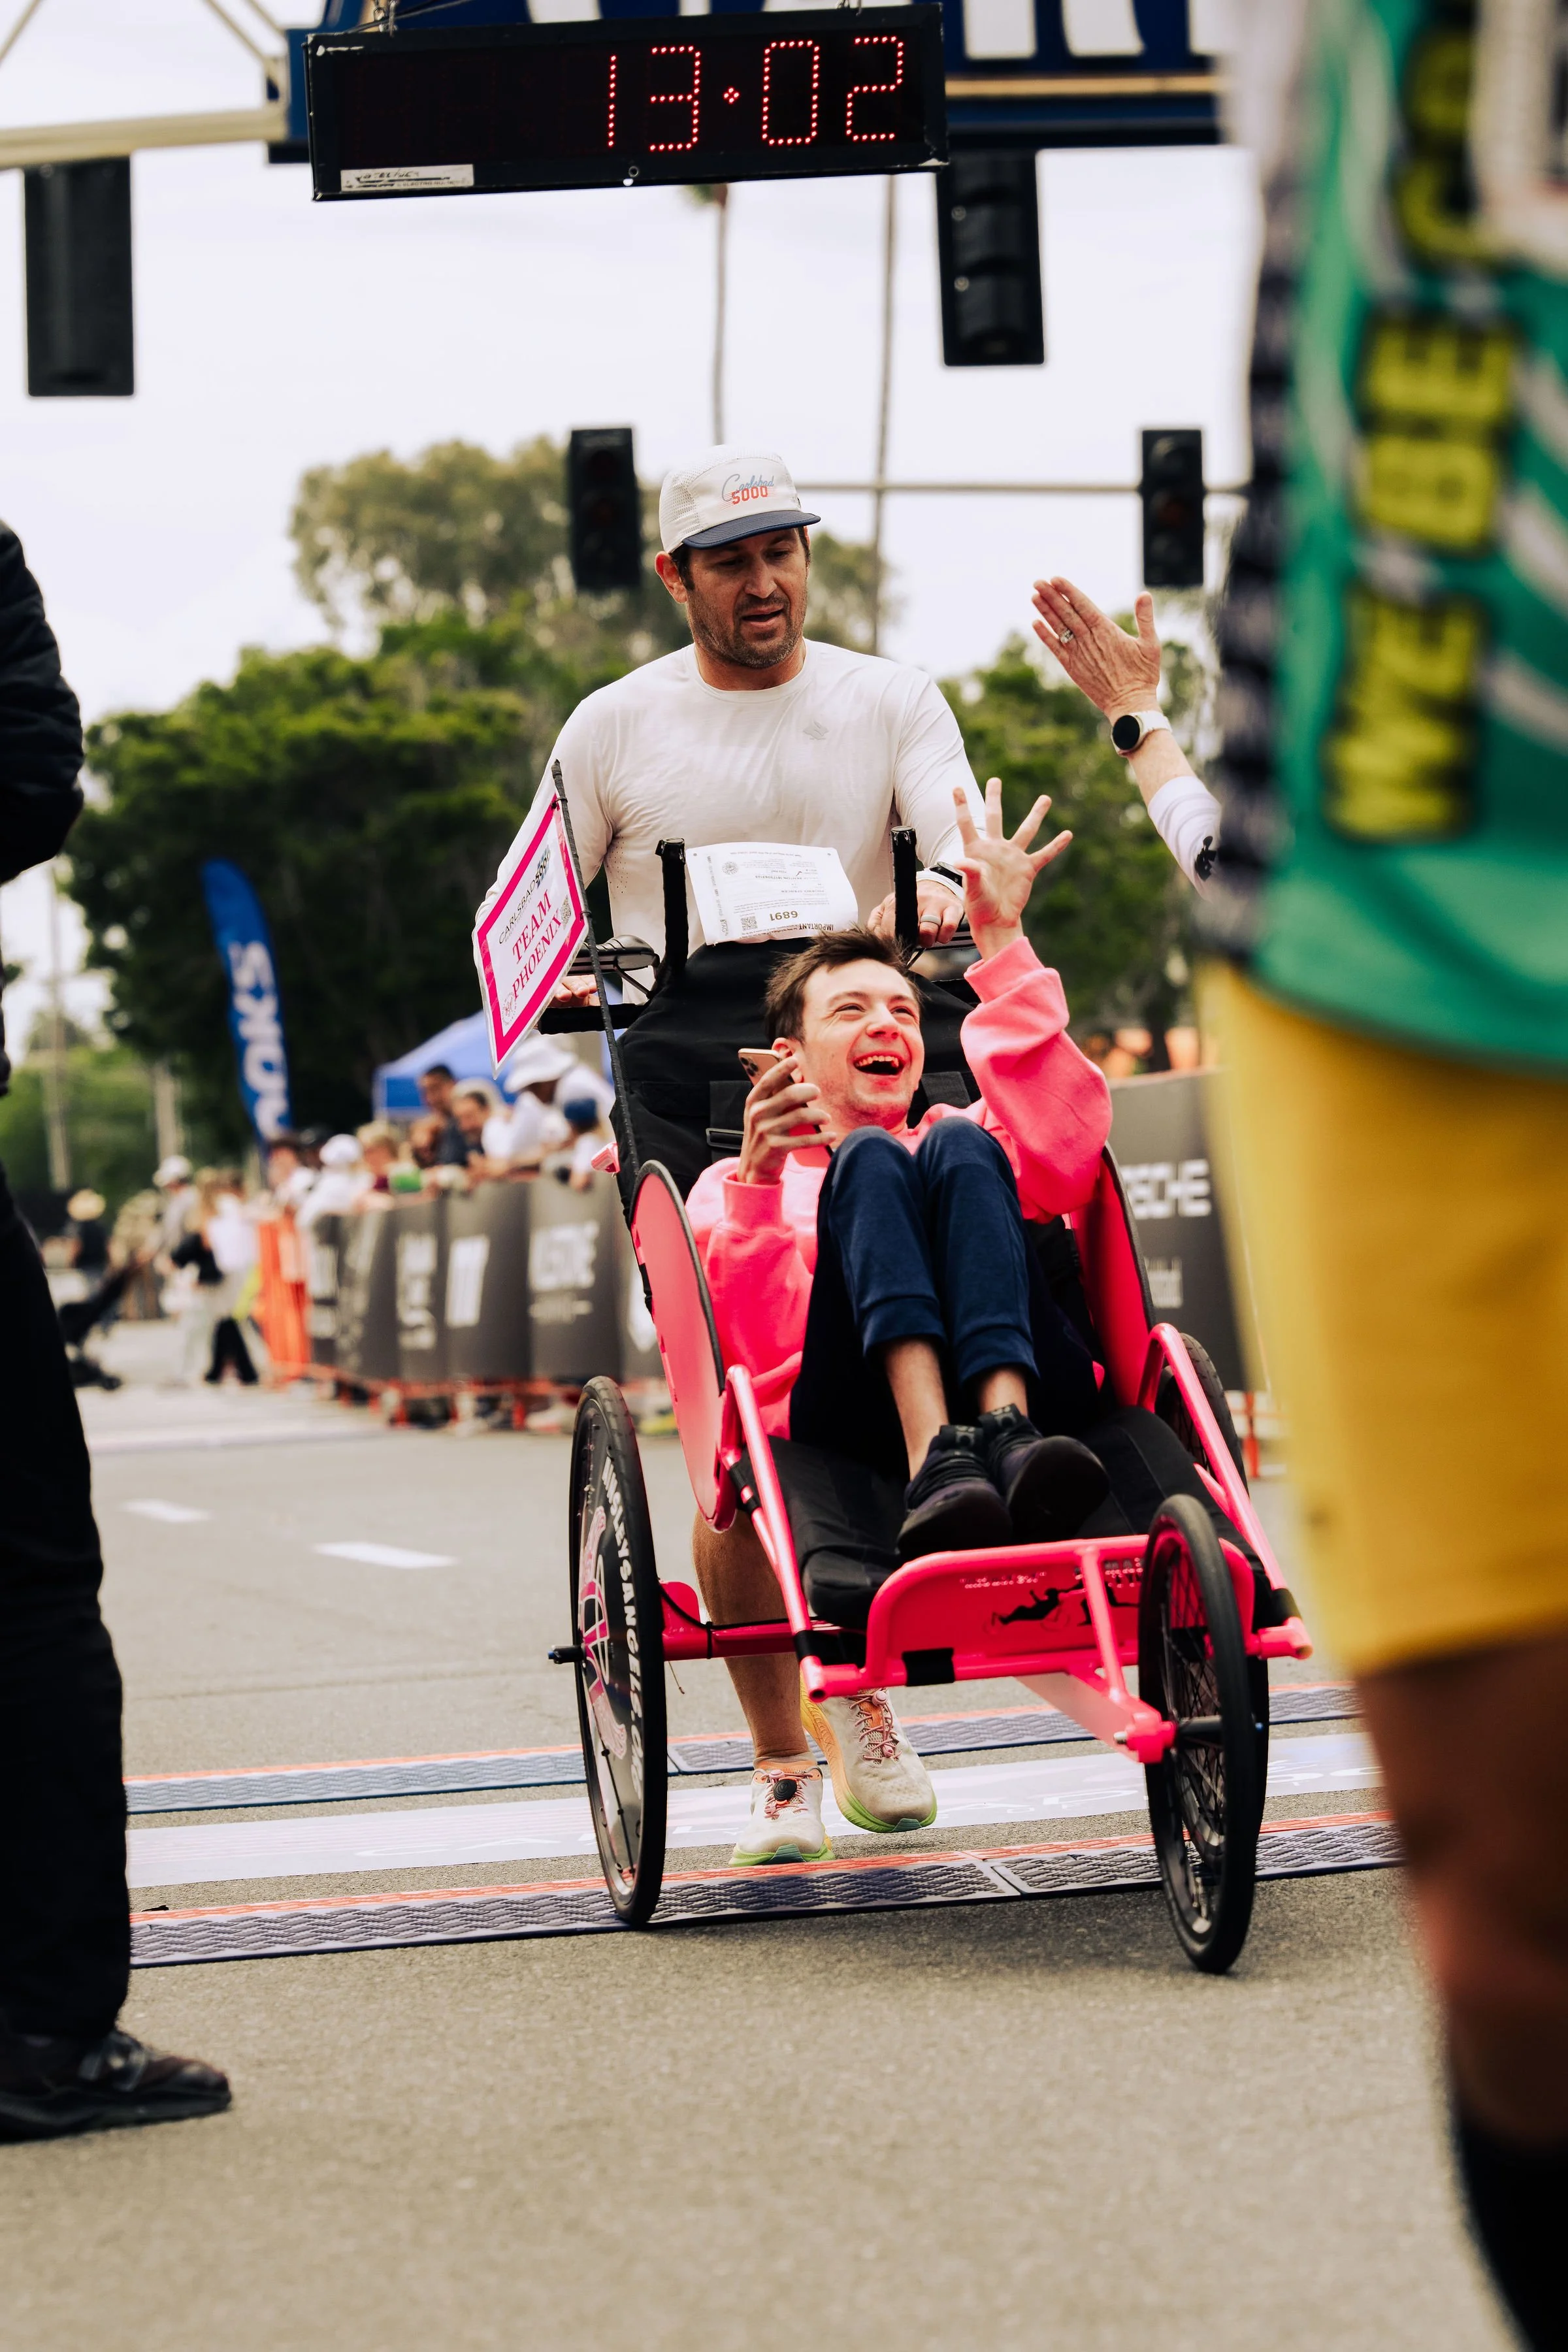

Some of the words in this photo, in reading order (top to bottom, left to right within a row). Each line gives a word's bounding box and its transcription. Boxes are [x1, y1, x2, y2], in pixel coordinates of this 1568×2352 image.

[721, 474, 774, 502] Carlsbad
[731, 485, 768, 504] 5000
[512, 889, 551, 964] TEAM
[770, 910, 798, 921] 6891
[798, 923, 834, 931] IMPORTANT
[512, 908, 562, 1000] PHOENIX
